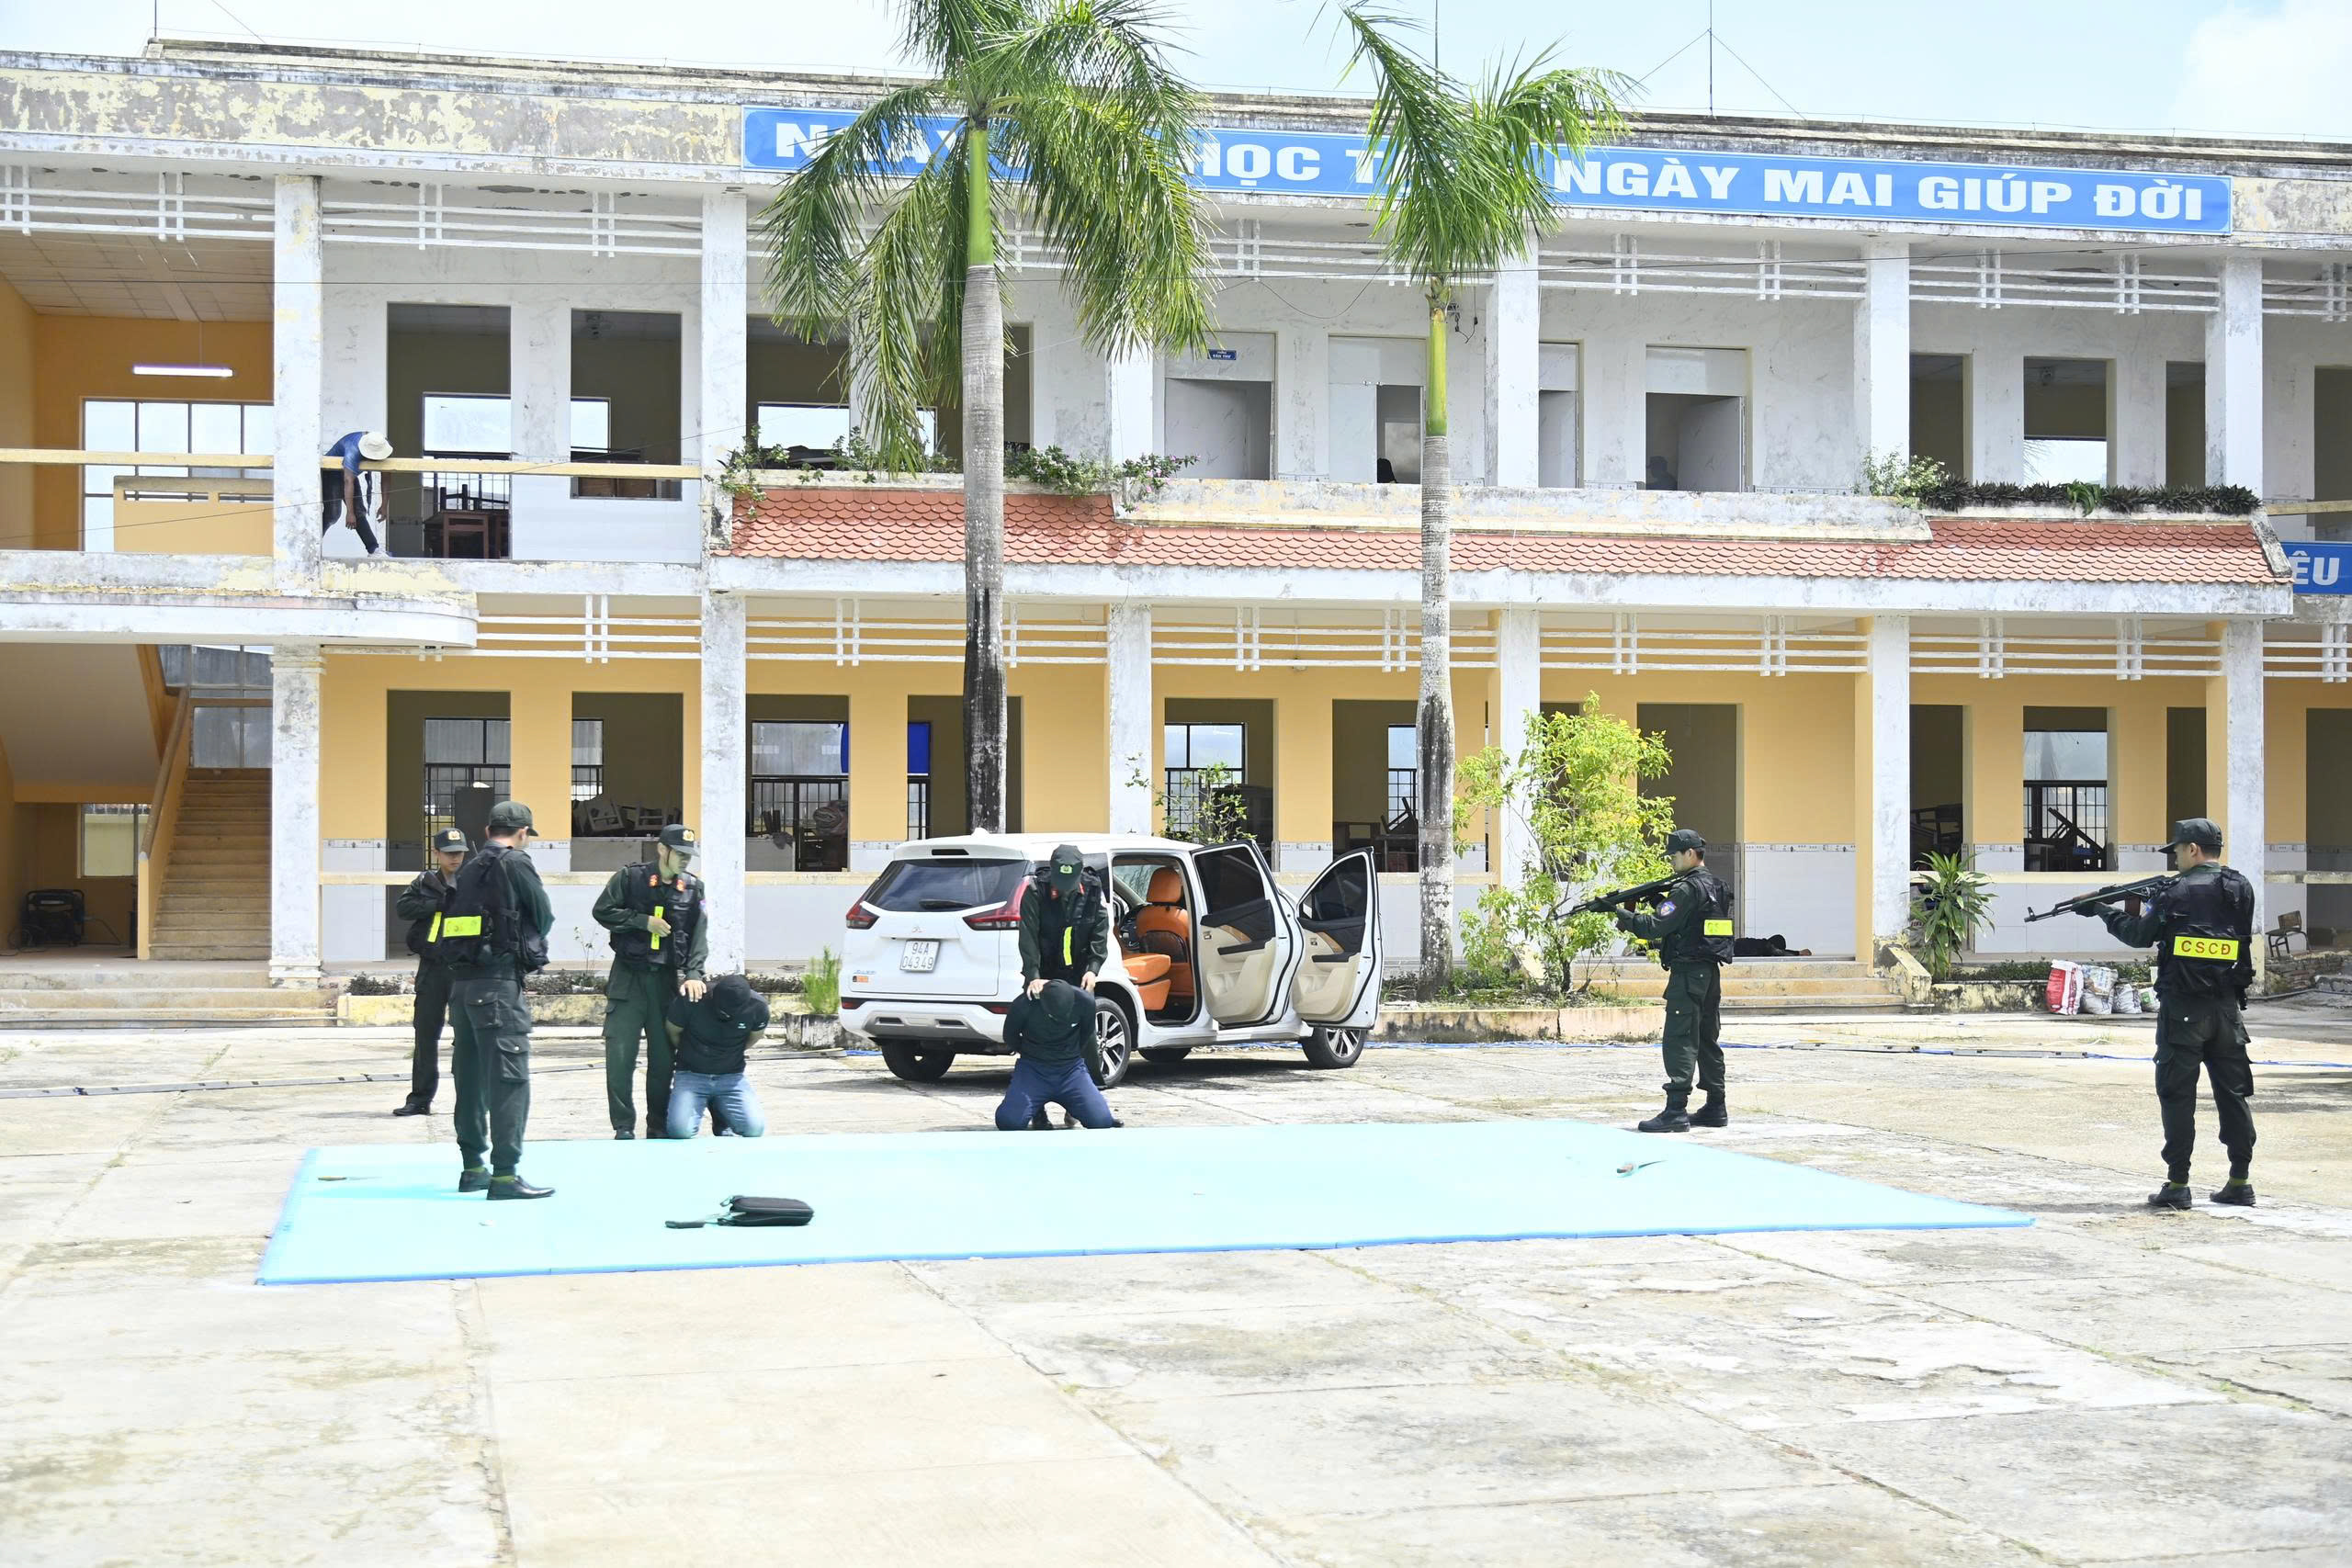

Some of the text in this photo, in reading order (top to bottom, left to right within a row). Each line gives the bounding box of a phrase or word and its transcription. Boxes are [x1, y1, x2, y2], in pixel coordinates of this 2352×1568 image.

[1174, 141, 1321, 186] HỌC
[1555, 157, 1739, 199] NGÀY
[1764, 169, 1892, 207] MAI
[1918, 174, 2072, 213] GIÚP
[2094, 179, 2201, 220] ĐỜI
[911, 942, 930, 954] 94A
[2181, 941, 2231, 955] CSCĐ
